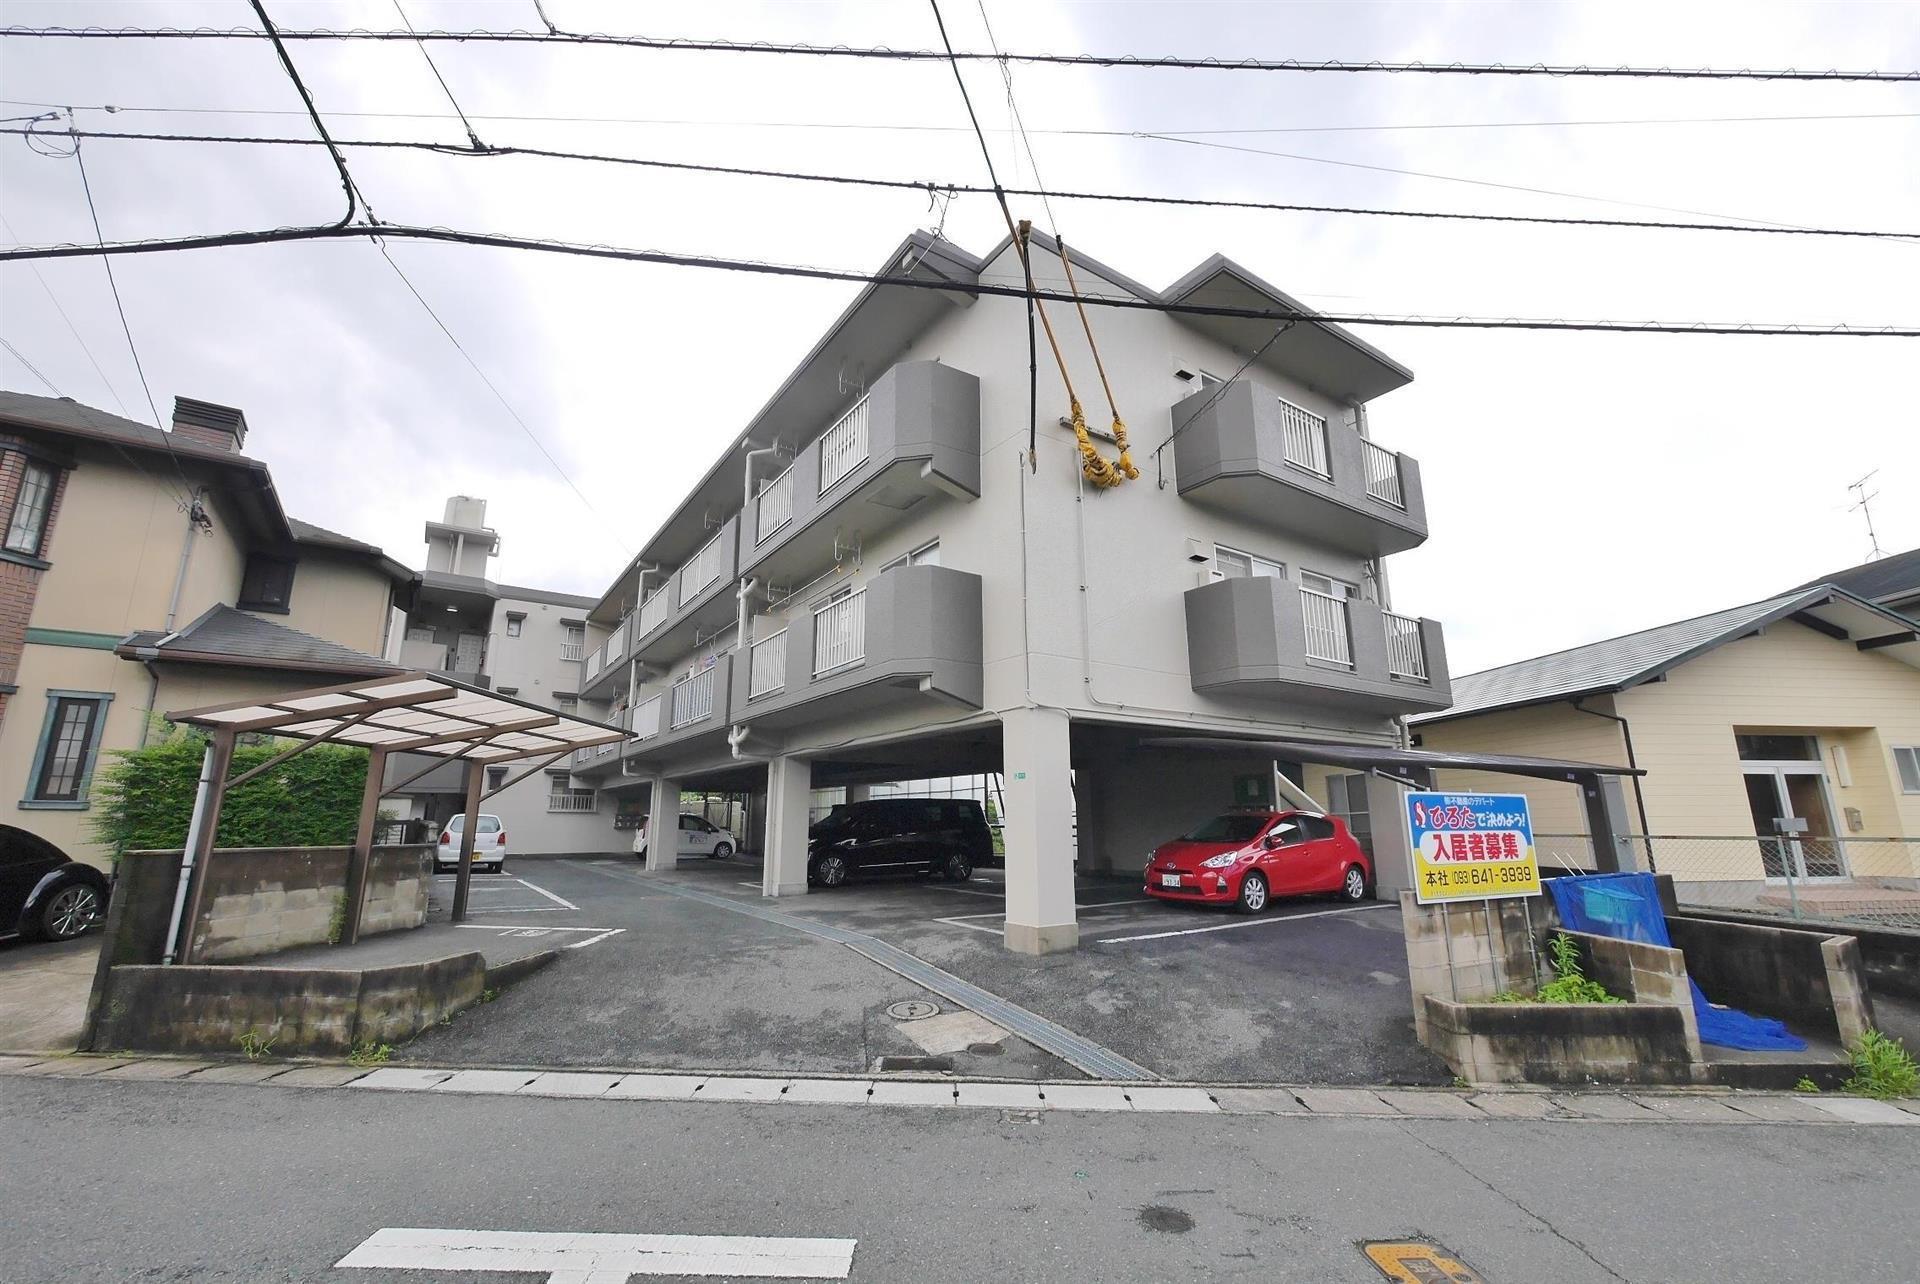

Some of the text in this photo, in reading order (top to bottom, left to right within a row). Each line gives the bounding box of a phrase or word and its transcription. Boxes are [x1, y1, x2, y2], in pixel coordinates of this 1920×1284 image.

[1433, 832, 1519, 861] 入居者募集
[1425, 870, 1449, 886] 本社
